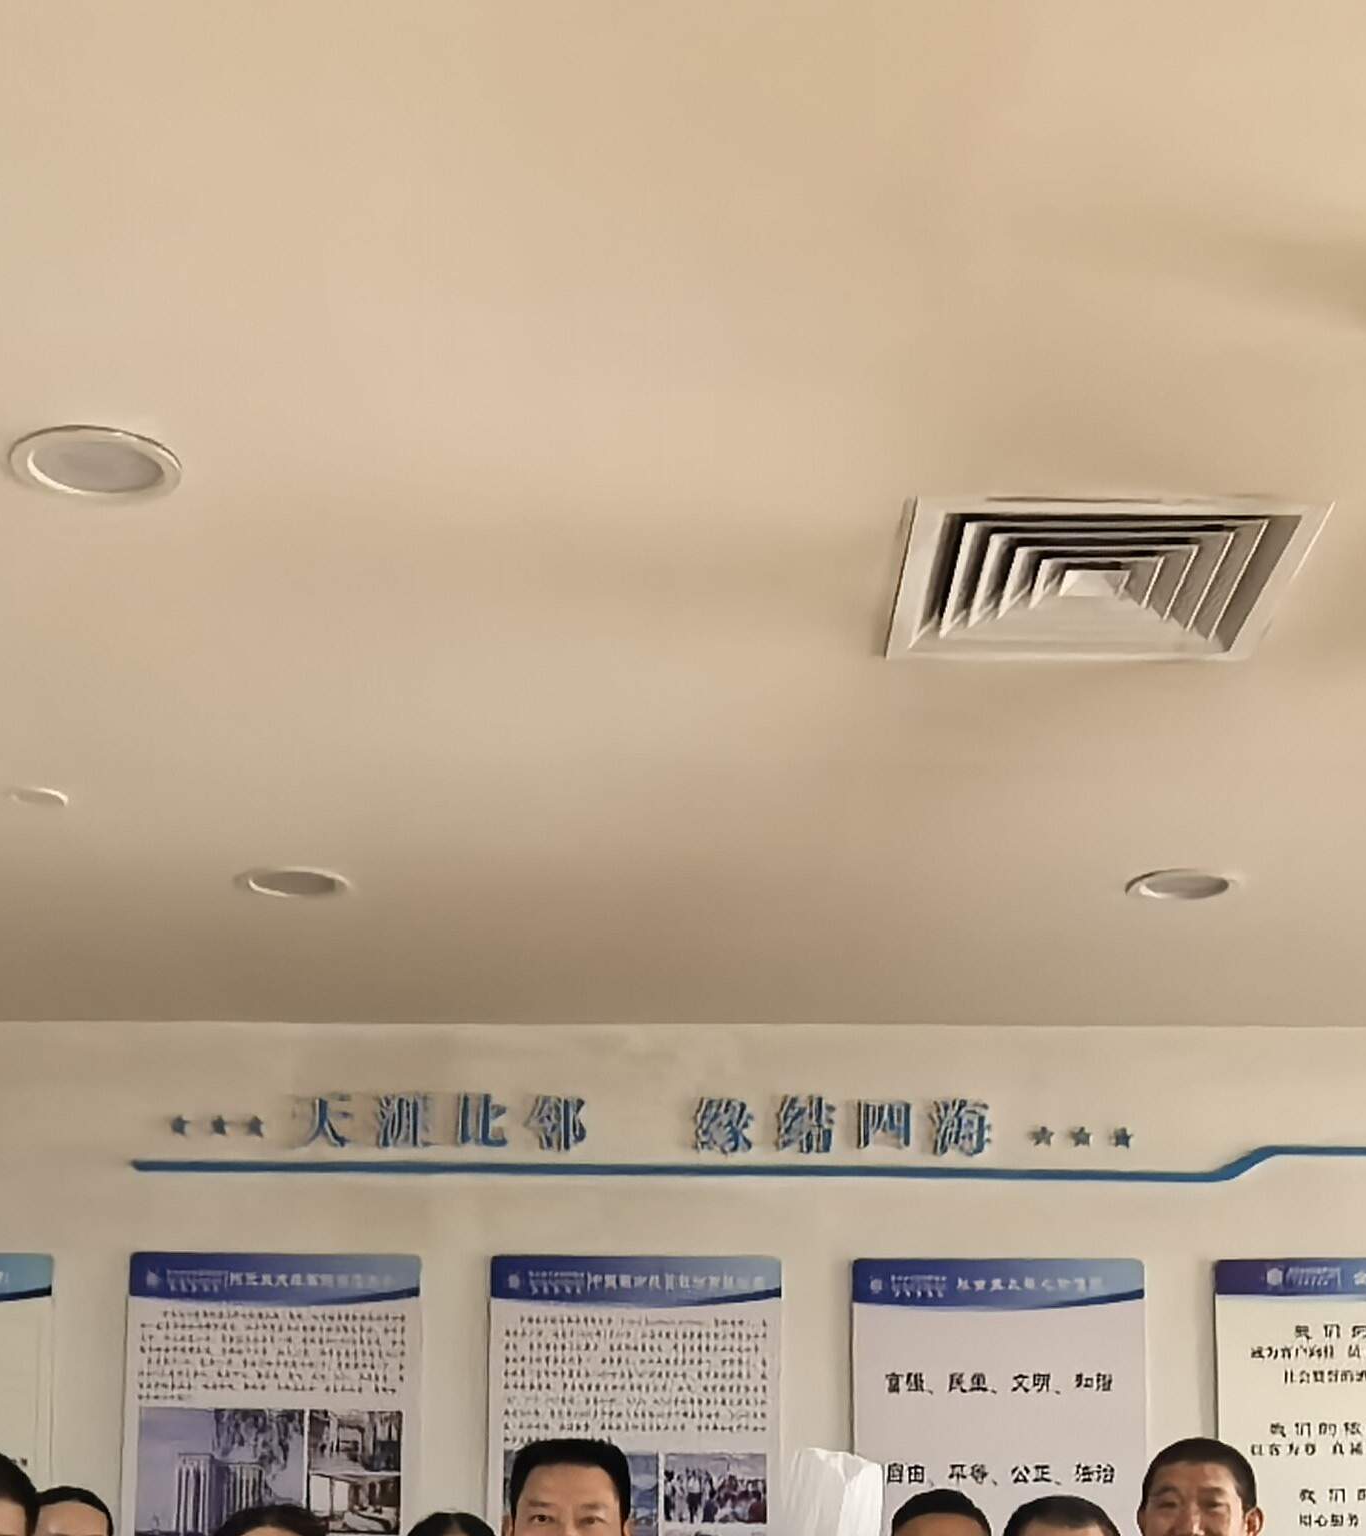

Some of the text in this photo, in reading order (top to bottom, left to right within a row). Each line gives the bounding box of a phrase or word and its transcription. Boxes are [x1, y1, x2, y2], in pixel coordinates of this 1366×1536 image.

[295, 1093, 992, 1158] 天涯比邻 缘结四海
